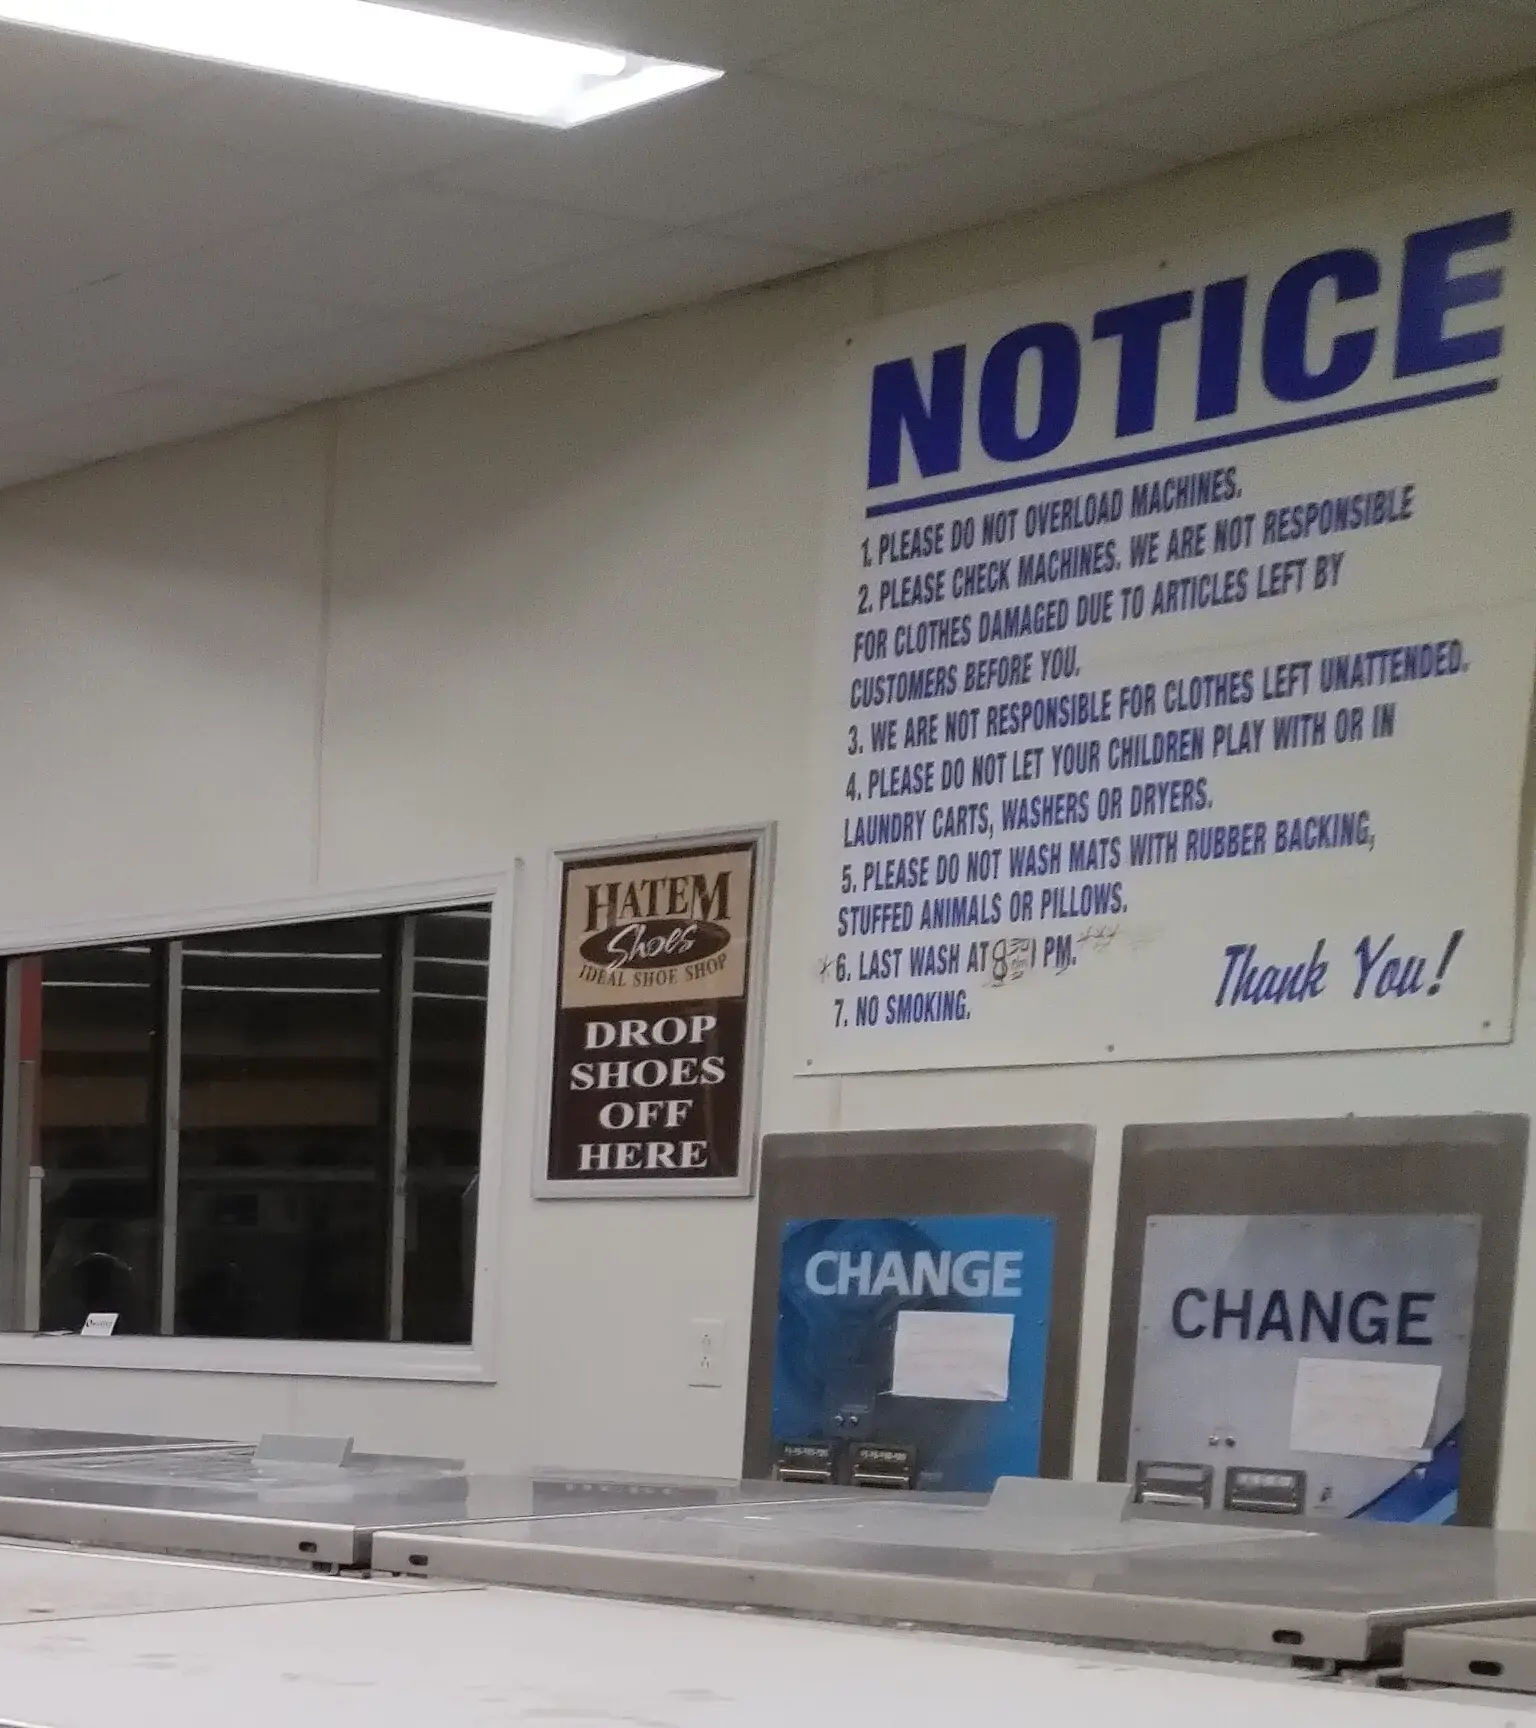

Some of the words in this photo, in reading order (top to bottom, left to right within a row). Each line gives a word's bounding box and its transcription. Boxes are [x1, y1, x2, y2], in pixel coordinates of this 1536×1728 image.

[867, 208, 1514, 490] NOTICE
[861, 536, 872, 567] 1.
[879, 522, 945, 565] PLEASE
[951, 516, 974, 552] DO
[981, 507, 1019, 546] NOT
[1026, 487, 1123, 538] OVERLOAD
[1130, 465, 1243, 518] MACHINES.
[857, 583, 873, 615] 2.
[879, 569, 946, 611] PLEASE
[951, 557, 1012, 599] CHECK
[1017, 539, 1121, 588] MACHINES.
[1129, 532, 1159, 568] WE
[1165, 522, 1207, 562] ARE
[1213, 513, 1257, 554] NOT
[1262, 482, 1415, 545] RESPONSIBLE
[853, 629, 889, 662] FOR
[894, 612, 972, 657] CLOTHES
[978, 597, 1069, 644] DAMAGED
[1075, 589, 1113, 627] DUE
[1120, 584, 1144, 620] TO
[1150, 566, 1249, 617] ARTICLES
[1257, 556, 1307, 599] LEFT
[1314, 550, 1345, 590] BY
[847, 724, 863, 756] 3.
[870, 718, 898, 752] WE
[904, 713, 938, 748] ARE
[945, 707, 980, 743] NOT
[986, 688, 1112, 737] RESPONSIBLE
[1119, 682, 1157, 719] FOR
[1164, 667, 1254, 713] CLOTHES
[1262, 660, 1313, 701] LEFT
[1320, 637, 1471, 693] UNATTENDED.
[849, 663, 957, 709] CUSTOMERS
[964, 651, 1033, 693] BEFORE
[1040, 645, 1081, 681] YOU.
[845, 770, 861, 801] 4.
[868, 760, 935, 799] PLEASE
[941, 757, 965, 791] DO
[972, 751, 1007, 786] NOT
[1012, 747, 1044, 782] LET
[1052, 739, 1100, 777] YOUR
[1108, 726, 1205, 770] CHILDREN
[1213, 718, 1265, 758] PLAY
[1273, 711, 1327, 751] WITH
[1334, 705, 1364, 744] OR
[1372, 702, 1397, 738] IN
[843, 809, 926, 848] LAUNDRY
[932, 801, 994, 840] CARTS,
[1002, 789, 1089, 831] WASHERS
[1097, 786, 1122, 821] OR
[1130, 776, 1213, 818] DRYERS.
[841, 863, 856, 894] 5.
[863, 855, 930, 892] PLEASE
[936, 852, 959, 886] DO
[966, 848, 1002, 882] NOT
[1009, 842, 1062, 878] WASH
[1069, 836, 1121, 872] MATS
[1129, 830, 1178, 866] WITH
[1185, 821, 1267, 862] RUBBER
[1275, 809, 1375, 854] BACKING,
[584, 870, 732, 933] HATEM
[837, 899, 914, 937] STUFFED
[919, 892, 1002, 931] ANIMALS
[1009, 889, 1034, 922] OR
[1040, 881, 1128, 920] PILLOWS.
[579, 964, 626, 987] IDEAL
[633, 968, 678, 987] SHOE
[685, 952, 727, 982] SHOP
[605, 921, 698, 973] Shoes
[835, 952, 851, 982] 6.
[858, 948, 903, 981] LAST
[910, 943, 960, 977] WASH
[966, 941, 990, 973] AT
[1043, 933, 1077, 968] PM.
[1215, 937, 1329, 1007] Thank
[1353, 928, 1465, 999] You!
[584, 1015, 718, 1050] DROP
[834, 998, 848, 1028] 7.
[855, 995, 879, 1027] NO
[885, 989, 971, 1025] SMOKING.
[570, 1056, 725, 1091] SHOES
[599, 1099, 693, 1131] OFF
[579, 1140, 708, 1171] HERE
[805, 1250, 1024, 1298] CHANGE
[1172, 1287, 1435, 1345] CHANGE
